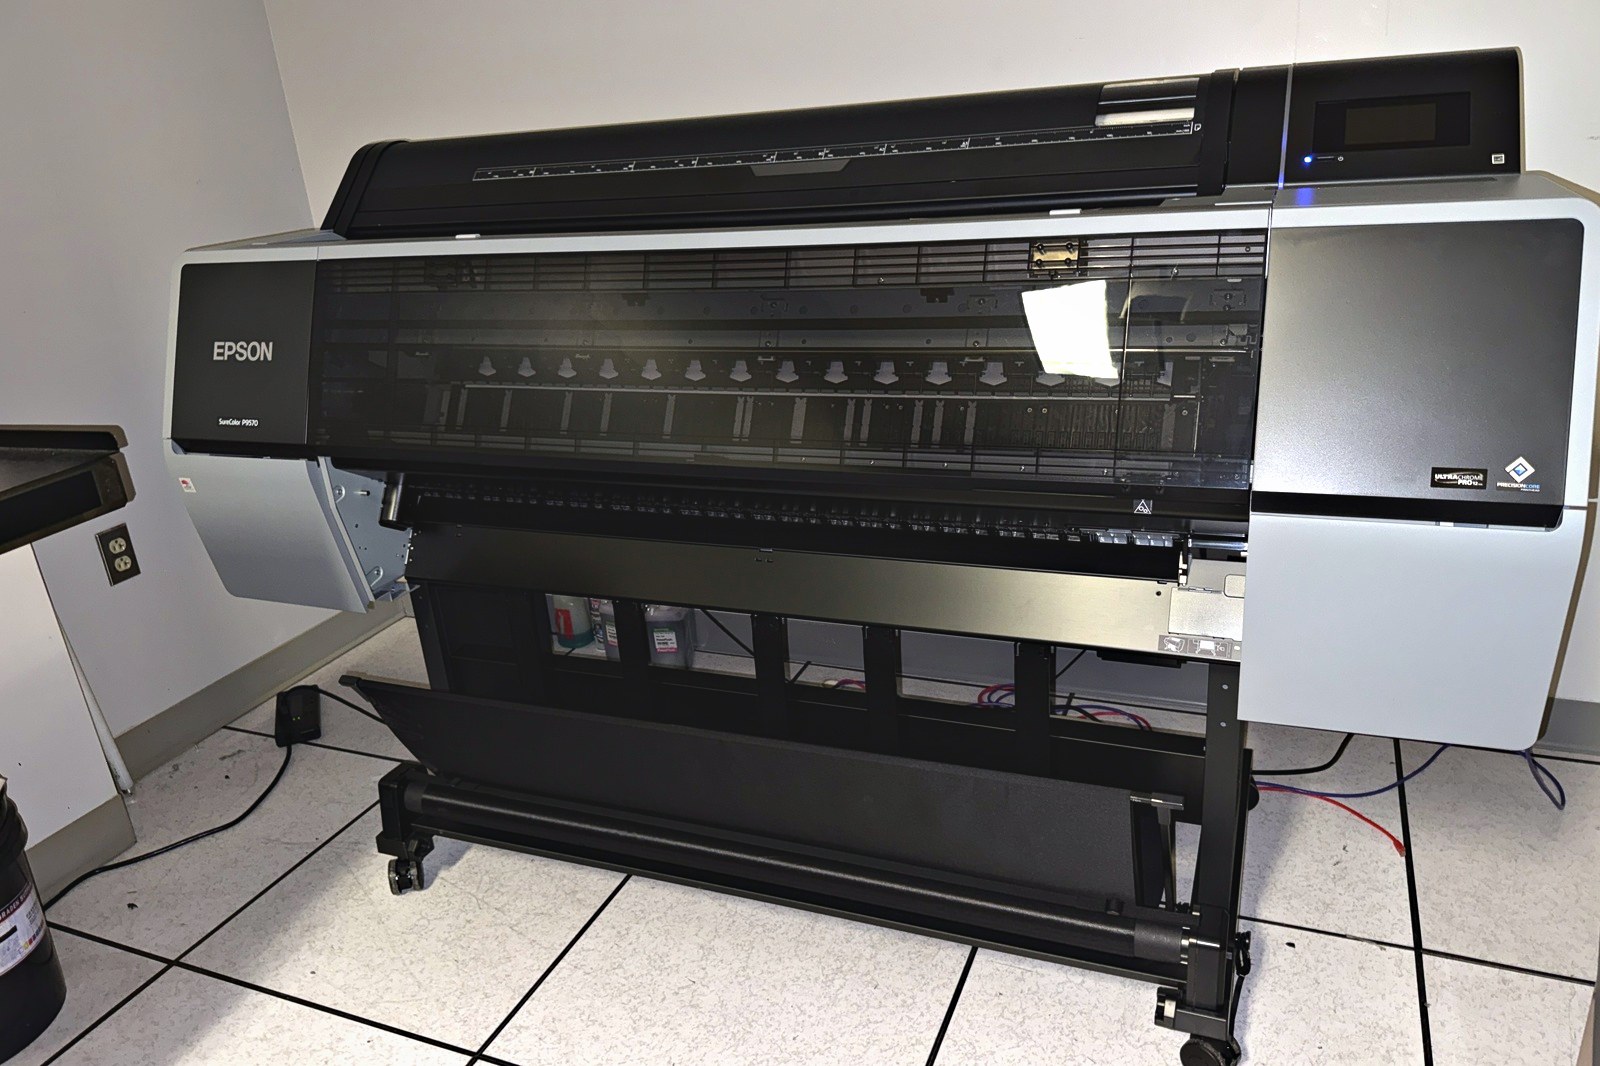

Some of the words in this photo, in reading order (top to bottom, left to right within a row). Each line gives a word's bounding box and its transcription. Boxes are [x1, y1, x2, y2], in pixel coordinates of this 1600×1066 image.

[213, 341, 273, 361] EPSON
[218, 418, 241, 426] SureColor
[241, 418, 259, 427] P9570
